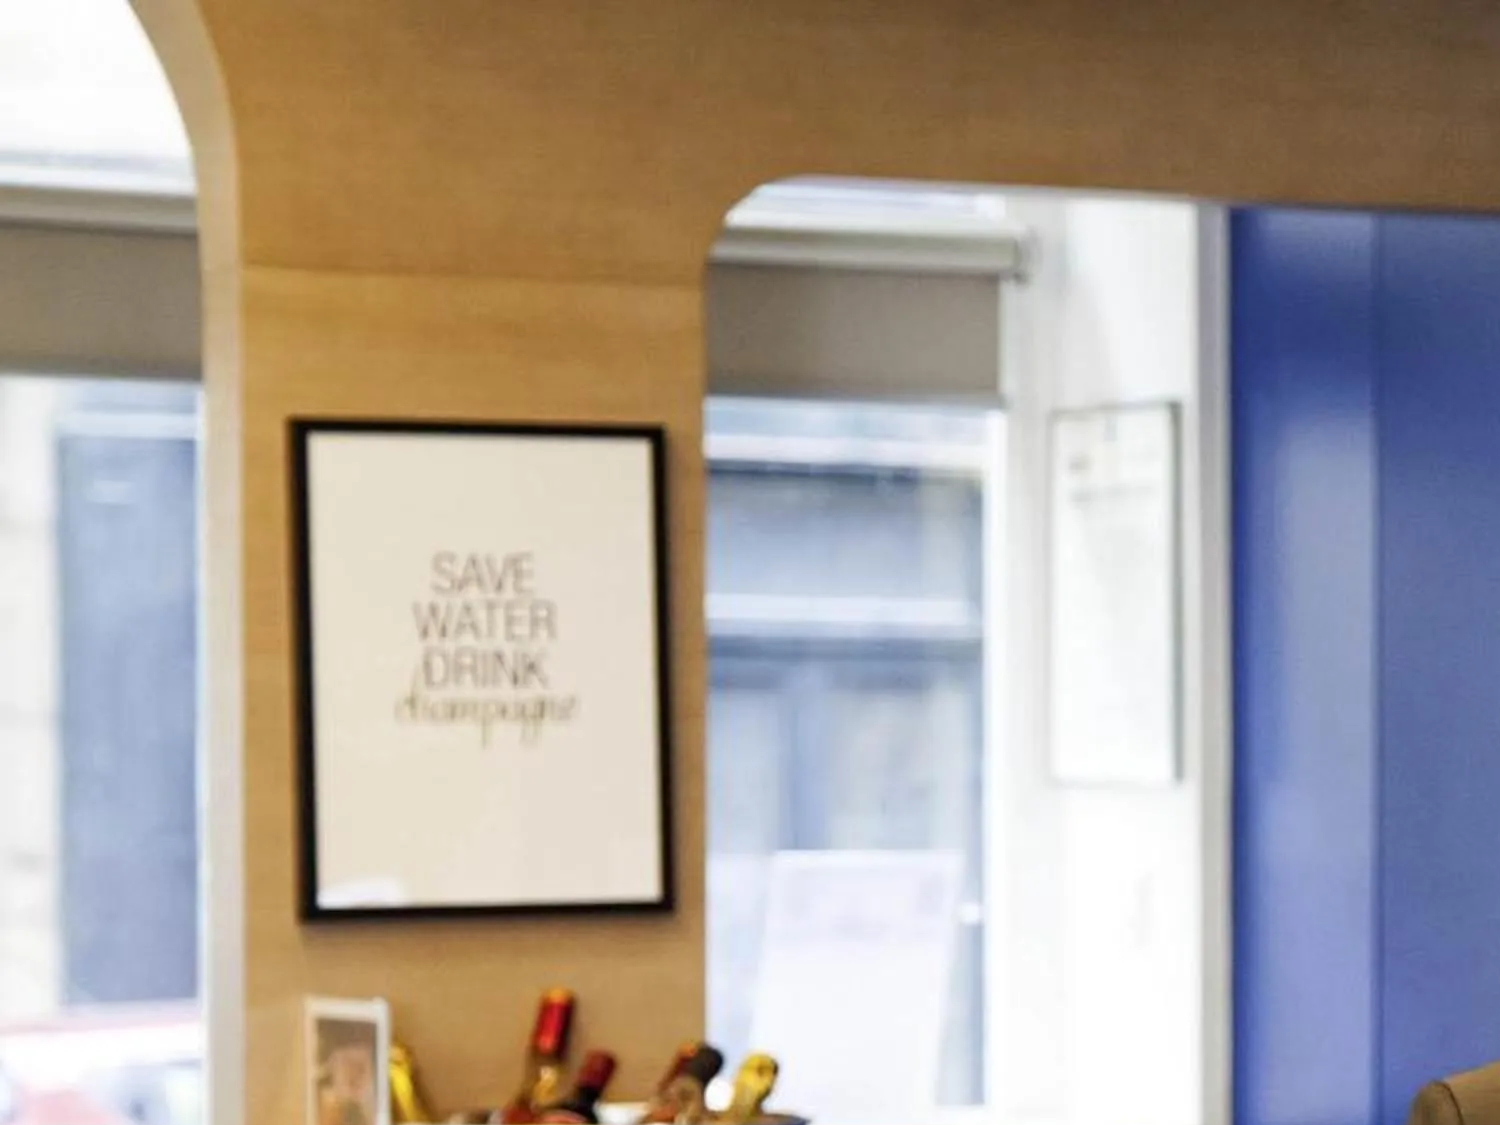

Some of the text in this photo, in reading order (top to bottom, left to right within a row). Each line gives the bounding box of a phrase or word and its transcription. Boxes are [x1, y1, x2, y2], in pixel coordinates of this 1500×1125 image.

[430, 550, 535, 594] SAVE
[411, 599, 558, 642] WATER
[421, 646, 550, 690] DRINK
